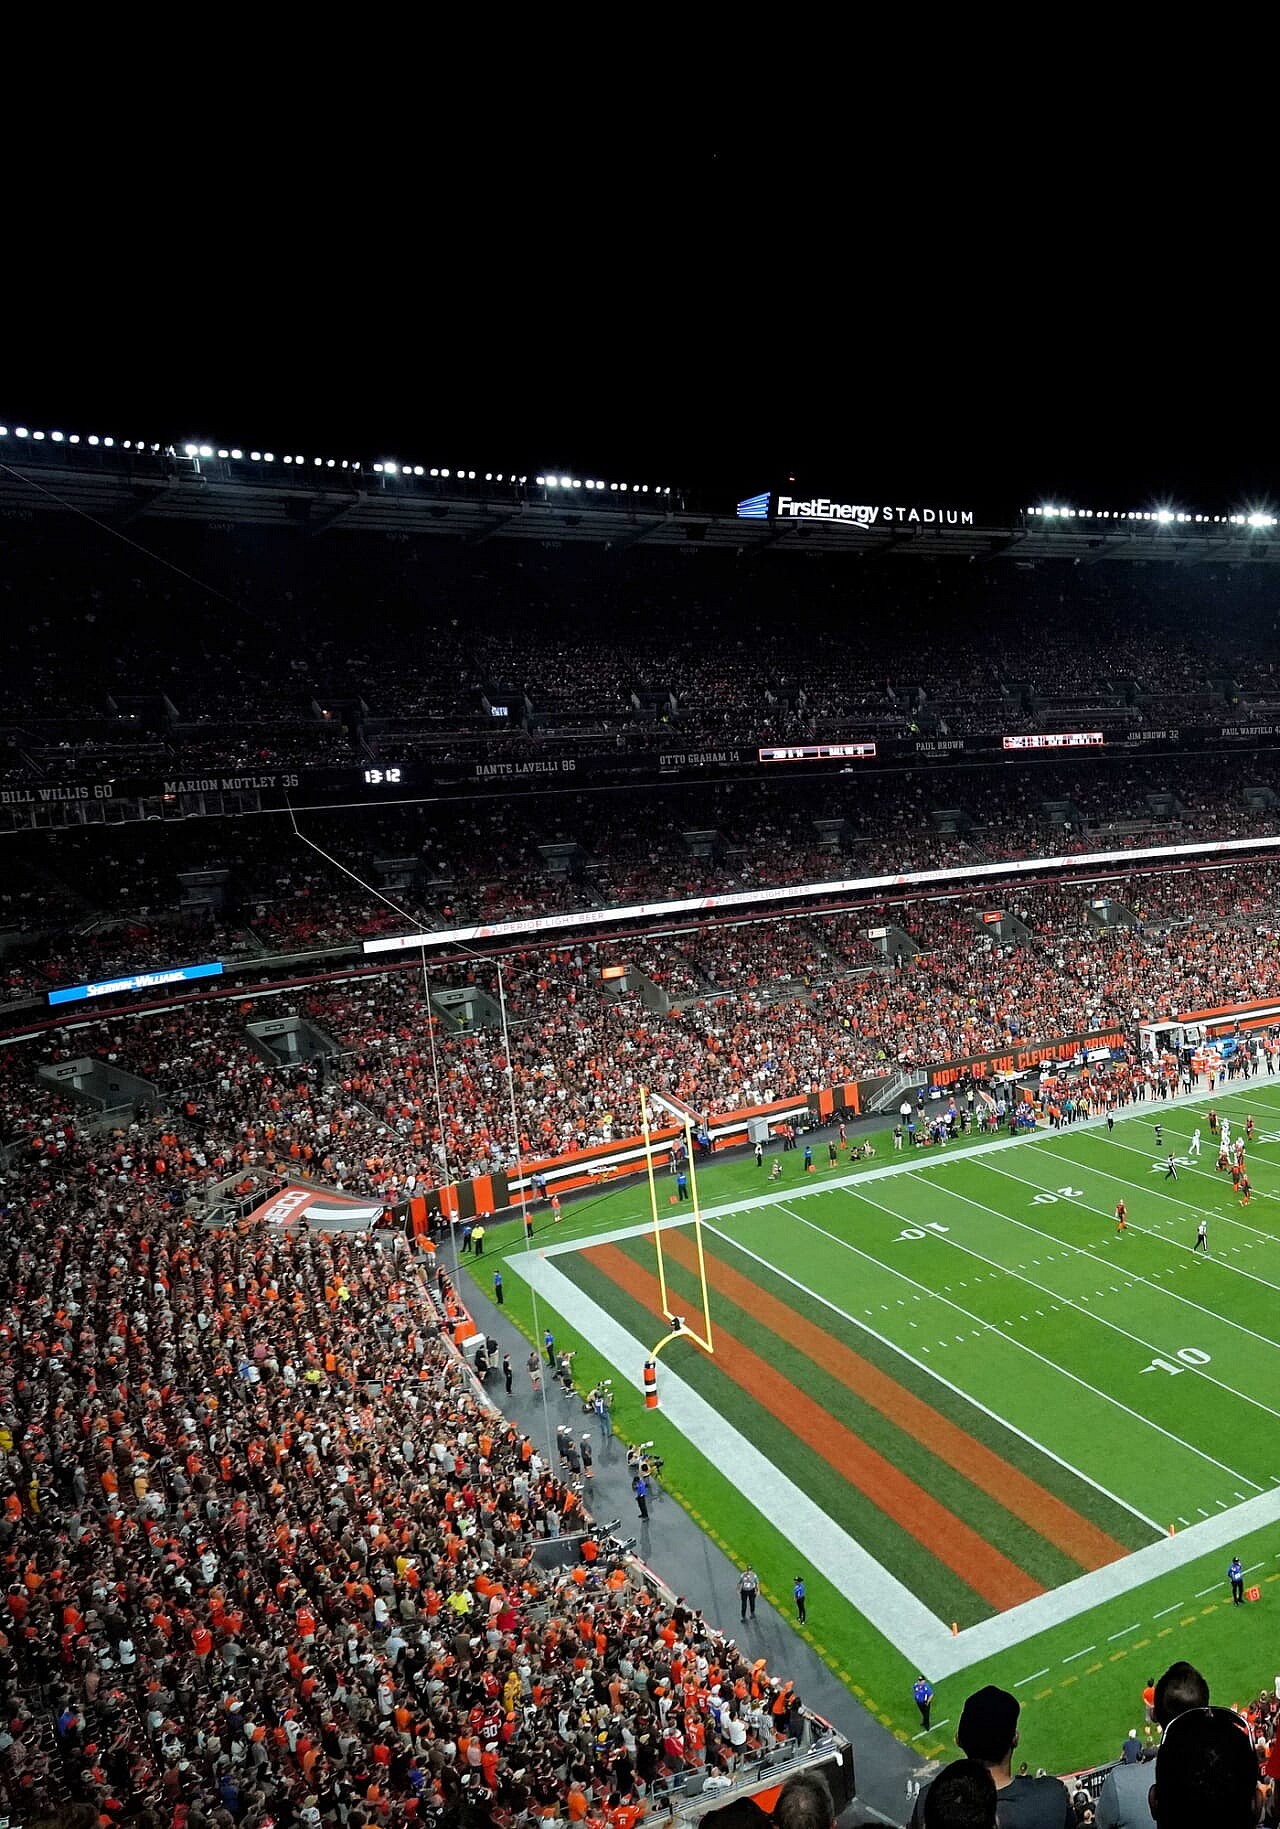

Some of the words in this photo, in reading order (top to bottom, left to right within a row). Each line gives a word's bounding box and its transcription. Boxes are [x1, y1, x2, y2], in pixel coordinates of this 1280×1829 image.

[777, 496, 879, 524] FirstEnergy
[882, 507, 974, 525] STADIUM
[915, 741, 936, 752] PAUL
[475, 763, 513, 776] DANTE
[515, 761, 559, 774] LAVELLI
[562, 759, 577, 772] 86
[659, 754, 686, 766] OTTO
[687, 752, 727, 764] GRAHAM
[729, 750, 740, 763] 14
[0, 791, 36, 803] BILL
[39, 786, 90, 801] WILLIS
[93, 784, 113, 799] 60
[162, 780, 220, 794] MARION
[222, 776, 277, 791] MOTLEY
[282, 774, 300, 788] 36
[933, 1064, 968, 1087] HOME
[991, 1055, 1015, 1072] THE
[1017, 1041, 1081, 1068] CLEVELAND
[1084, 1033, 1124, 1050] BROWN
[1150, 1347, 1212, 1377] 10
[1250, 1588, 1258, 1600] G
